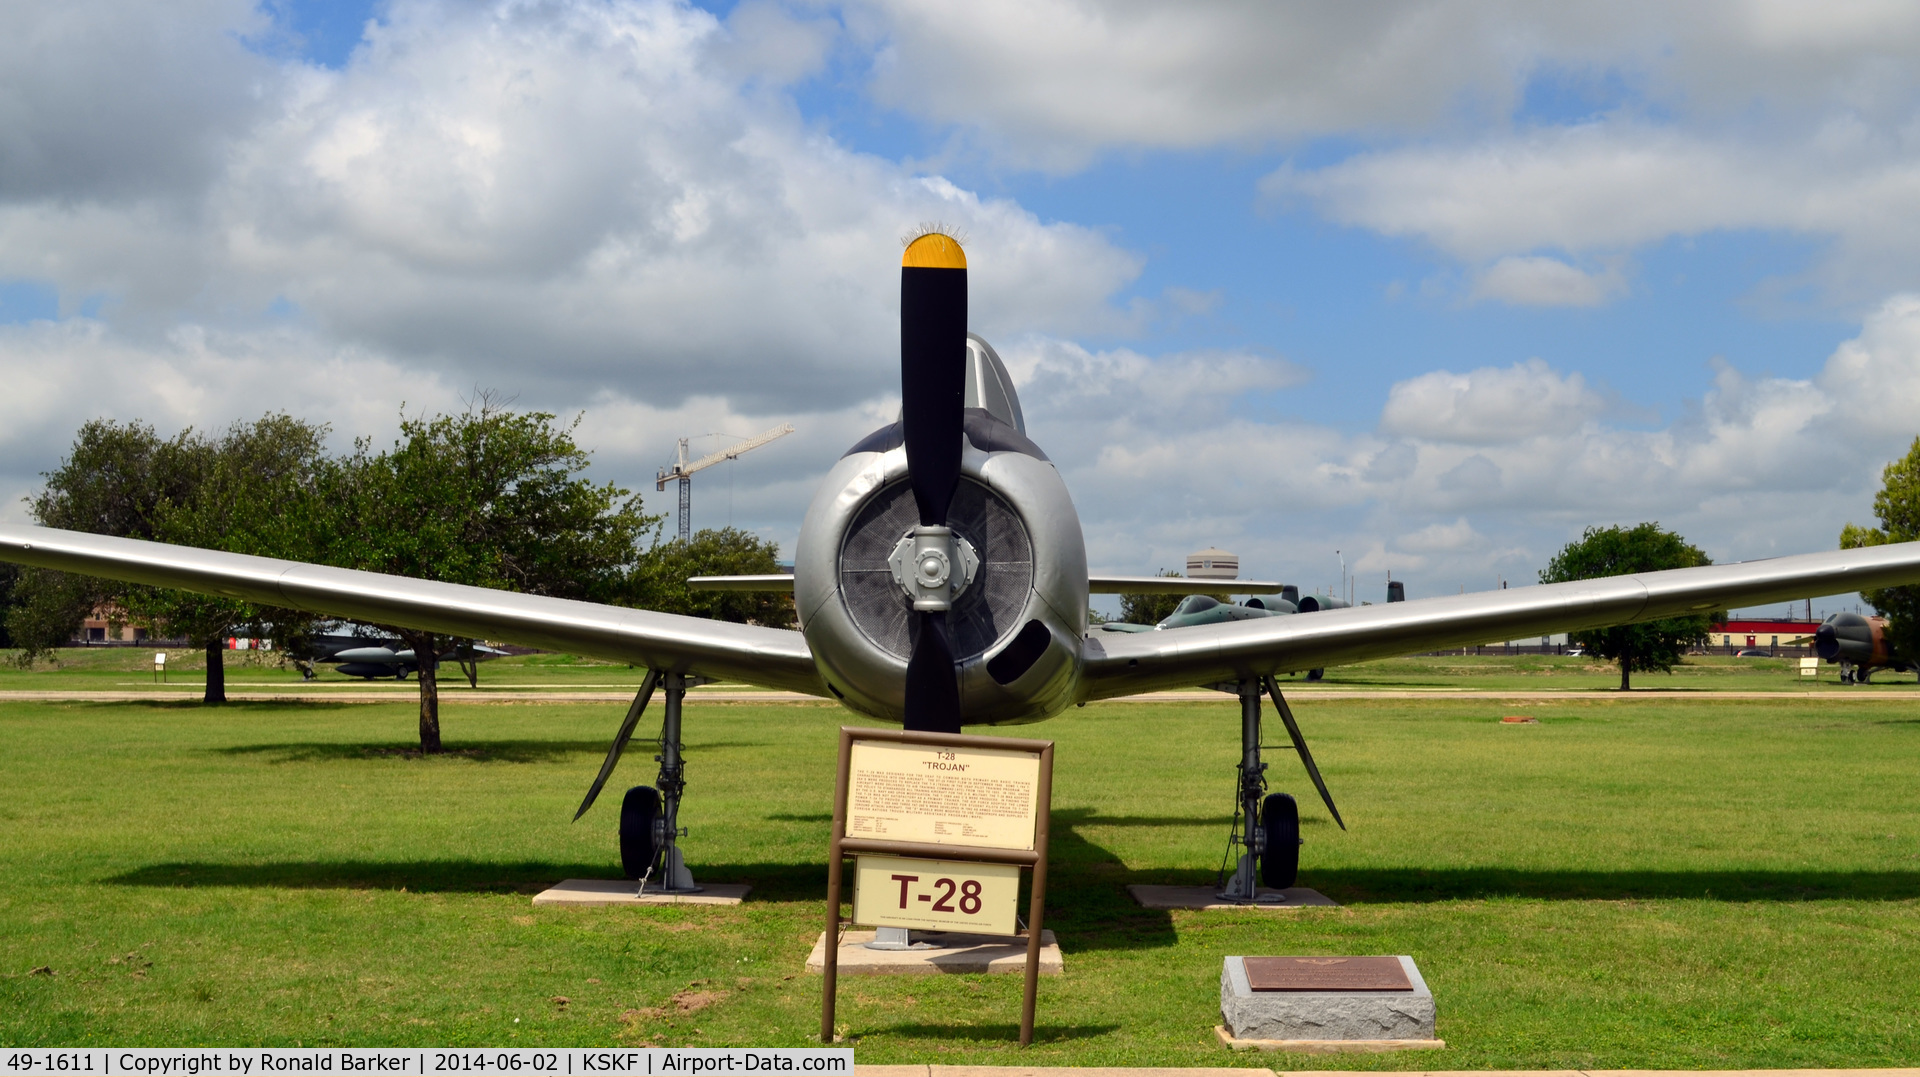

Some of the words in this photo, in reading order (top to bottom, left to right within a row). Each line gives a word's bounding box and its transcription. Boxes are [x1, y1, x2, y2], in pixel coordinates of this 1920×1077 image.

[936, 751, 955, 760] T-28
[922, 761, 970, 772] "TROJAN"
[891, 874, 982, 915] T-28
